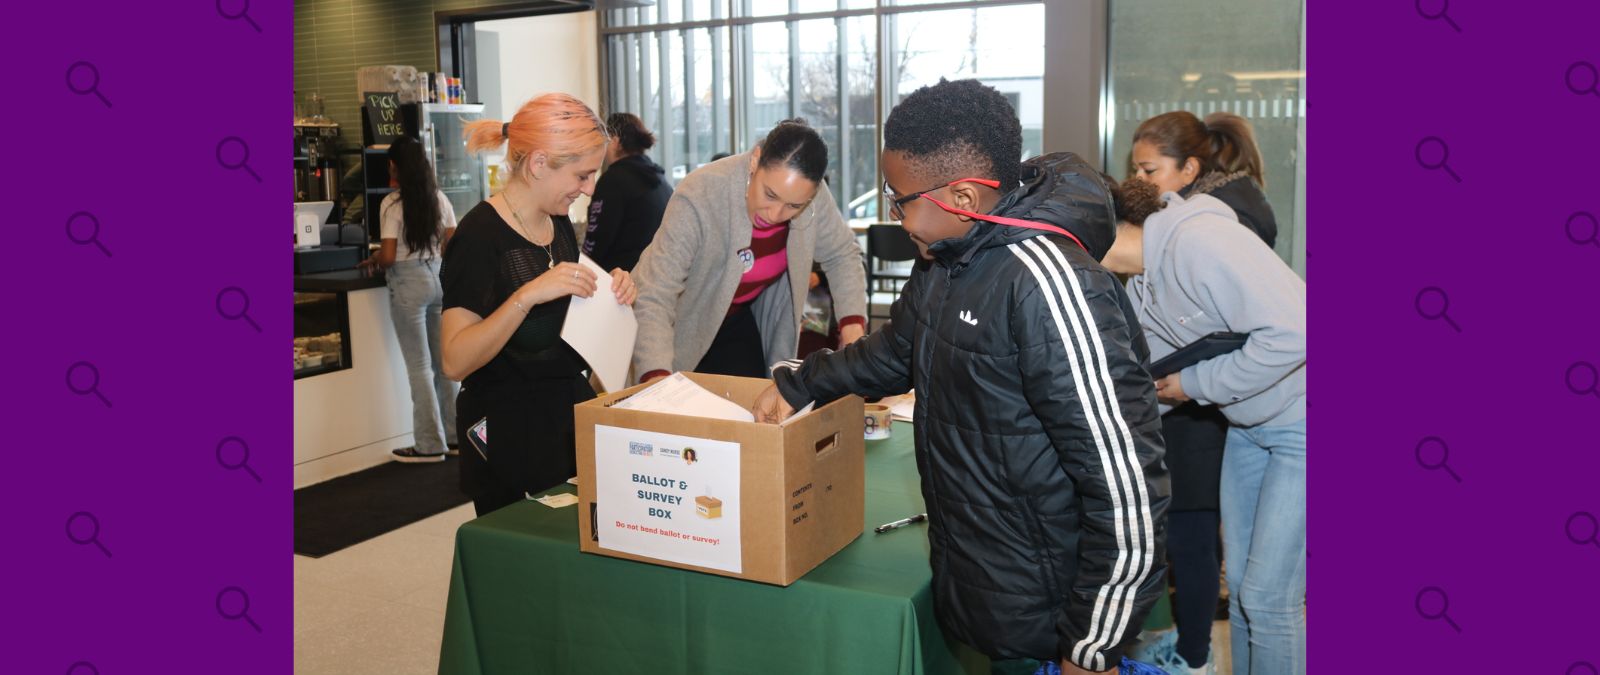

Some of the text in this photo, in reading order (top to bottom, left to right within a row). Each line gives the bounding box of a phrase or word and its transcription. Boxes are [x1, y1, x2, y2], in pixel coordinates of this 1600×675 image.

[368, 94, 398, 109] PICK
[380, 108, 394, 121] UP
[377, 123, 404, 135] HERE
[632, 473, 688, 490] BALLOT &
[637, 490, 682, 505] SURVEY
[648, 507, 672, 519] BOX
[615, 520, 625, 528] Do
[626, 523, 638, 531] not
[640, 525, 658, 535] bend
[659, 529, 681, 539] ballot
[692, 535, 720, 545] survey!
